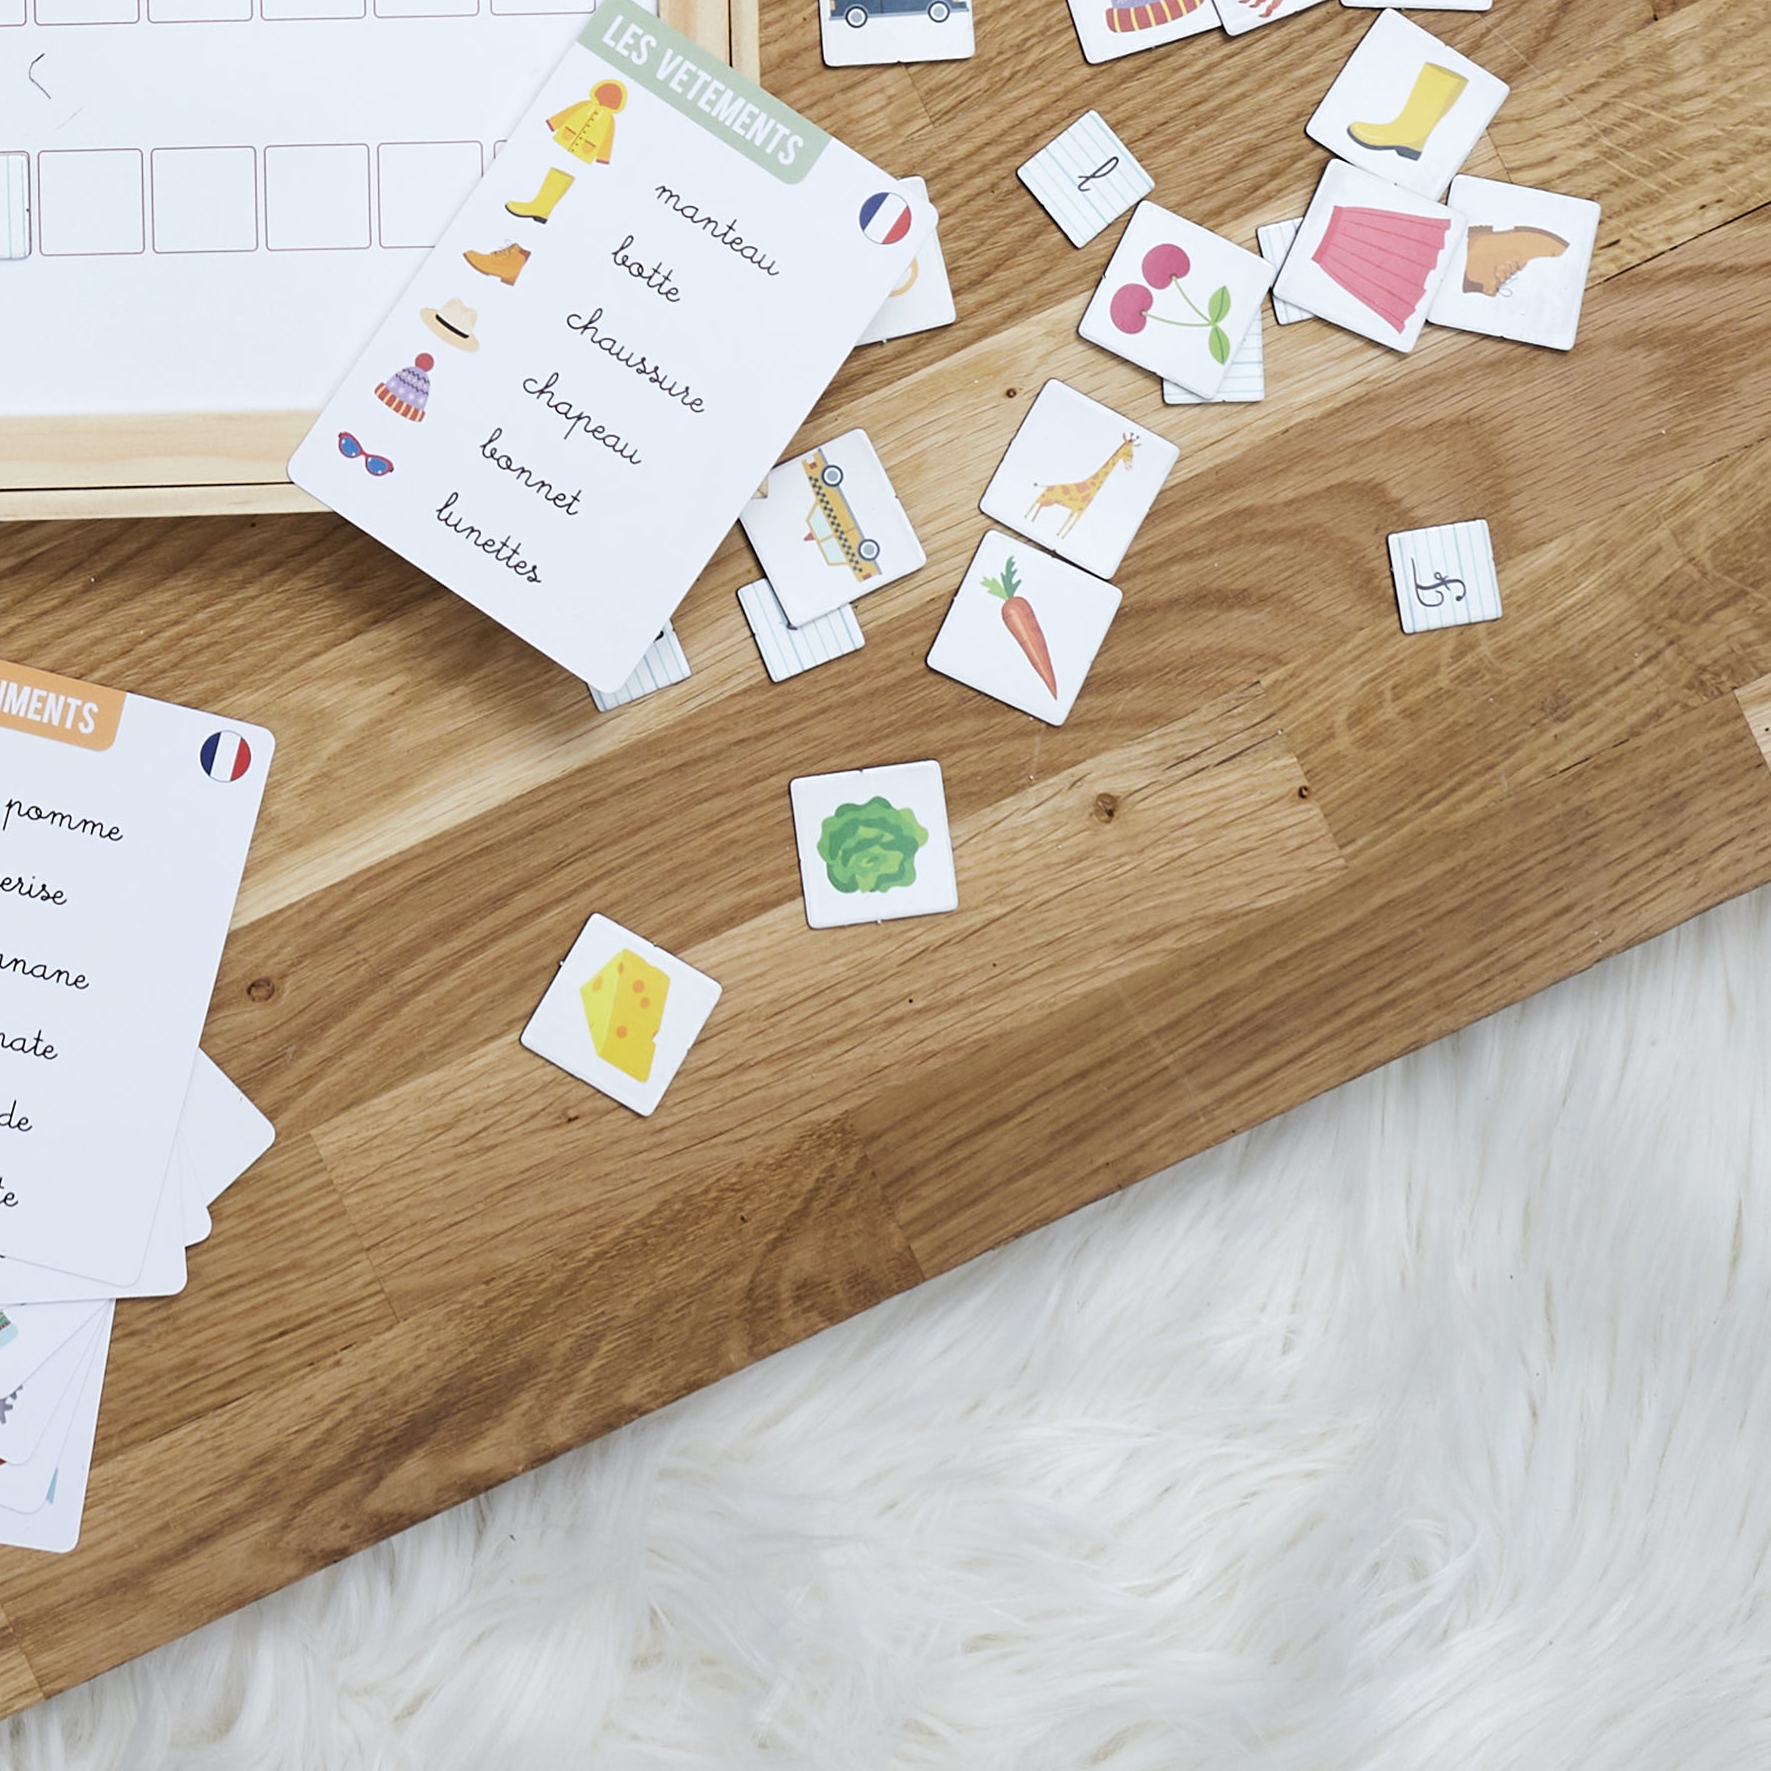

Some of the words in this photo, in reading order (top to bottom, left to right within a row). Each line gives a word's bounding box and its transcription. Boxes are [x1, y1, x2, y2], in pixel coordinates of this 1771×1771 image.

[602, 14, 657, 66] LES
[655, 48, 804, 166] VETEMENTS
[611, 234, 681, 303] botte
[654, 183, 780, 278] manteau
[565, 307, 705, 415] chaussure
[522, 372, 642, 468] chapeau
[479, 427, 582, 517] bonnet
[435, 492, 541, 585] lunettes
[2, 798, 124, 842] pomme
